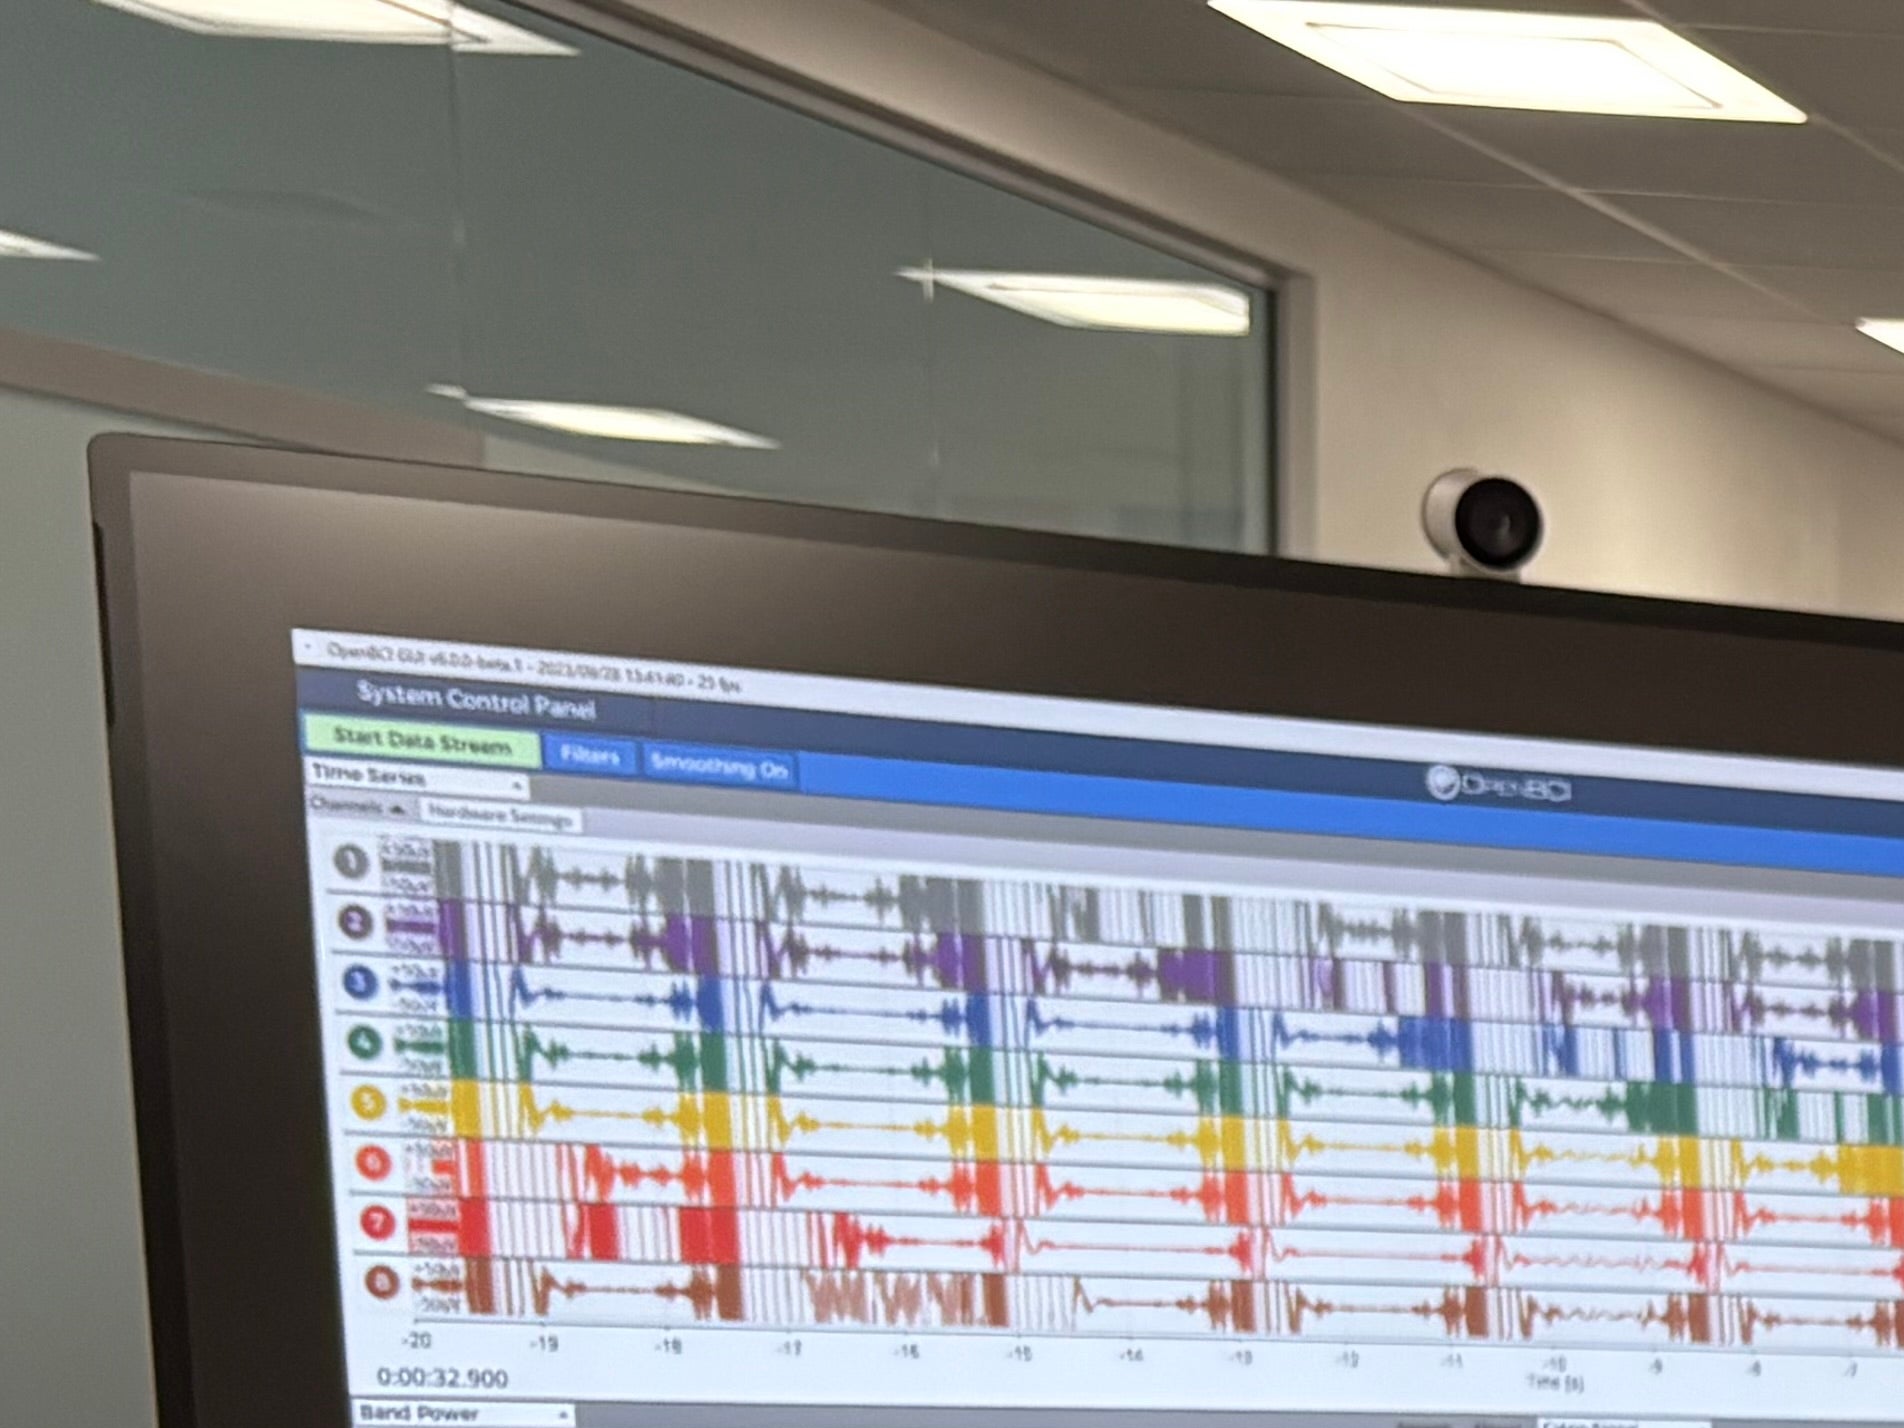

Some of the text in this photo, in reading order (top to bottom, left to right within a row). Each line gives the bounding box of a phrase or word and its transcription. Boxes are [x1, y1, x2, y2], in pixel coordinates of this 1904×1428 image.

[357, 679, 597, 720] System Control Panel
[334, 725, 513, 755] Start Data Stream
[561, 744, 621, 765] Filters
[312, 763, 364, 782] Time
[651, 751, 789, 781] Smoothing On
[401, 1331, 432, 1349] -20
[376, 1366, 509, 1390] 0:00:32.900
[360, 1404, 480, 1422] Band Power
